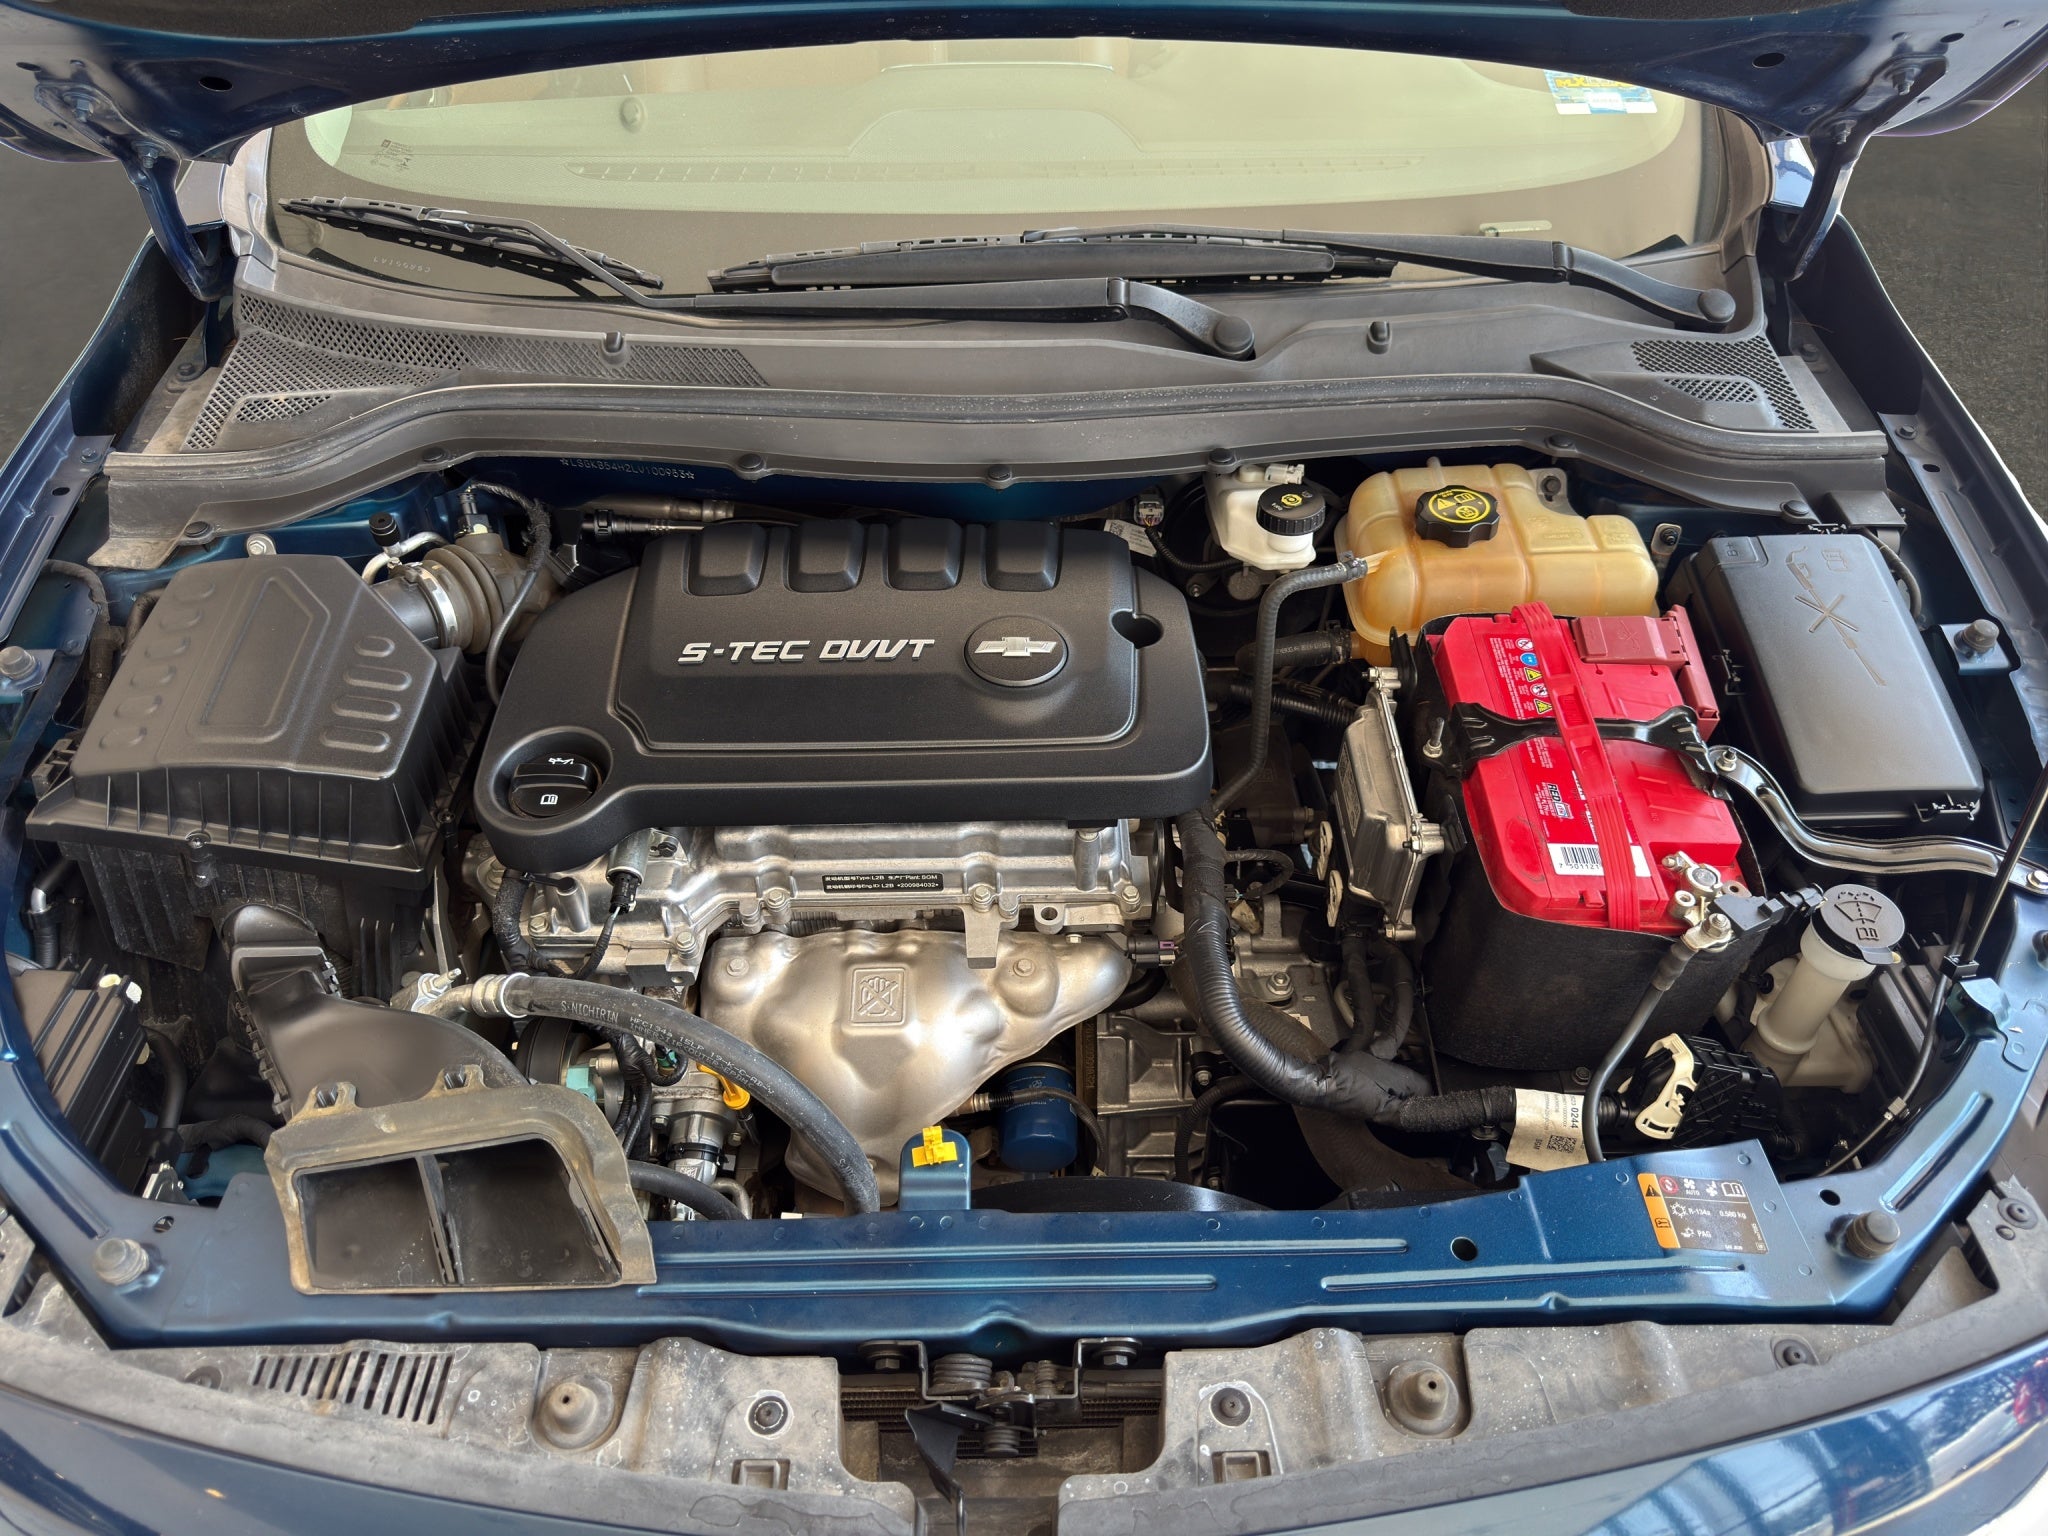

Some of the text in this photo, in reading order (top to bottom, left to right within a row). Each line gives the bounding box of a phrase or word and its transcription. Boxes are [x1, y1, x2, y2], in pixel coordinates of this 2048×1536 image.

[678, 639, 935, 664] S-TEC DVVT
[1570, 1107, 1579, 1129] 0244
